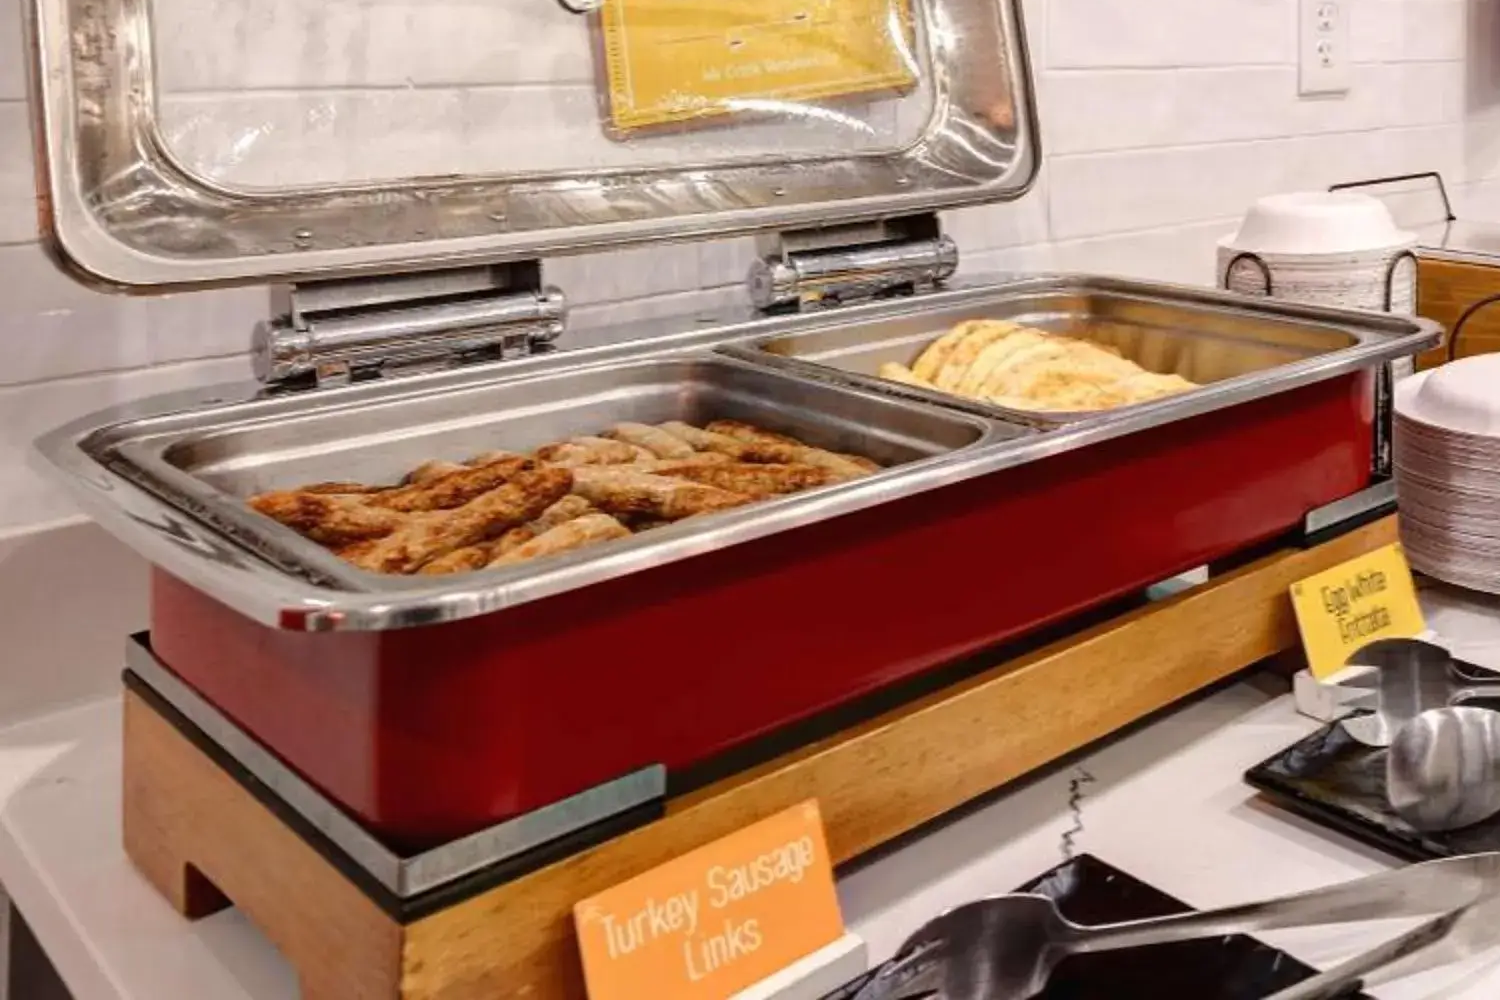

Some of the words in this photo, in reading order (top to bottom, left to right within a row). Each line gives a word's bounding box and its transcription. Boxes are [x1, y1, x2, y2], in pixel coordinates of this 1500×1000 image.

[1320, 585, 1349, 618] Egg
[600, 889, 699, 960] Turkey
[707, 836, 815, 908] Sausage
[683, 917, 763, 982] Links
